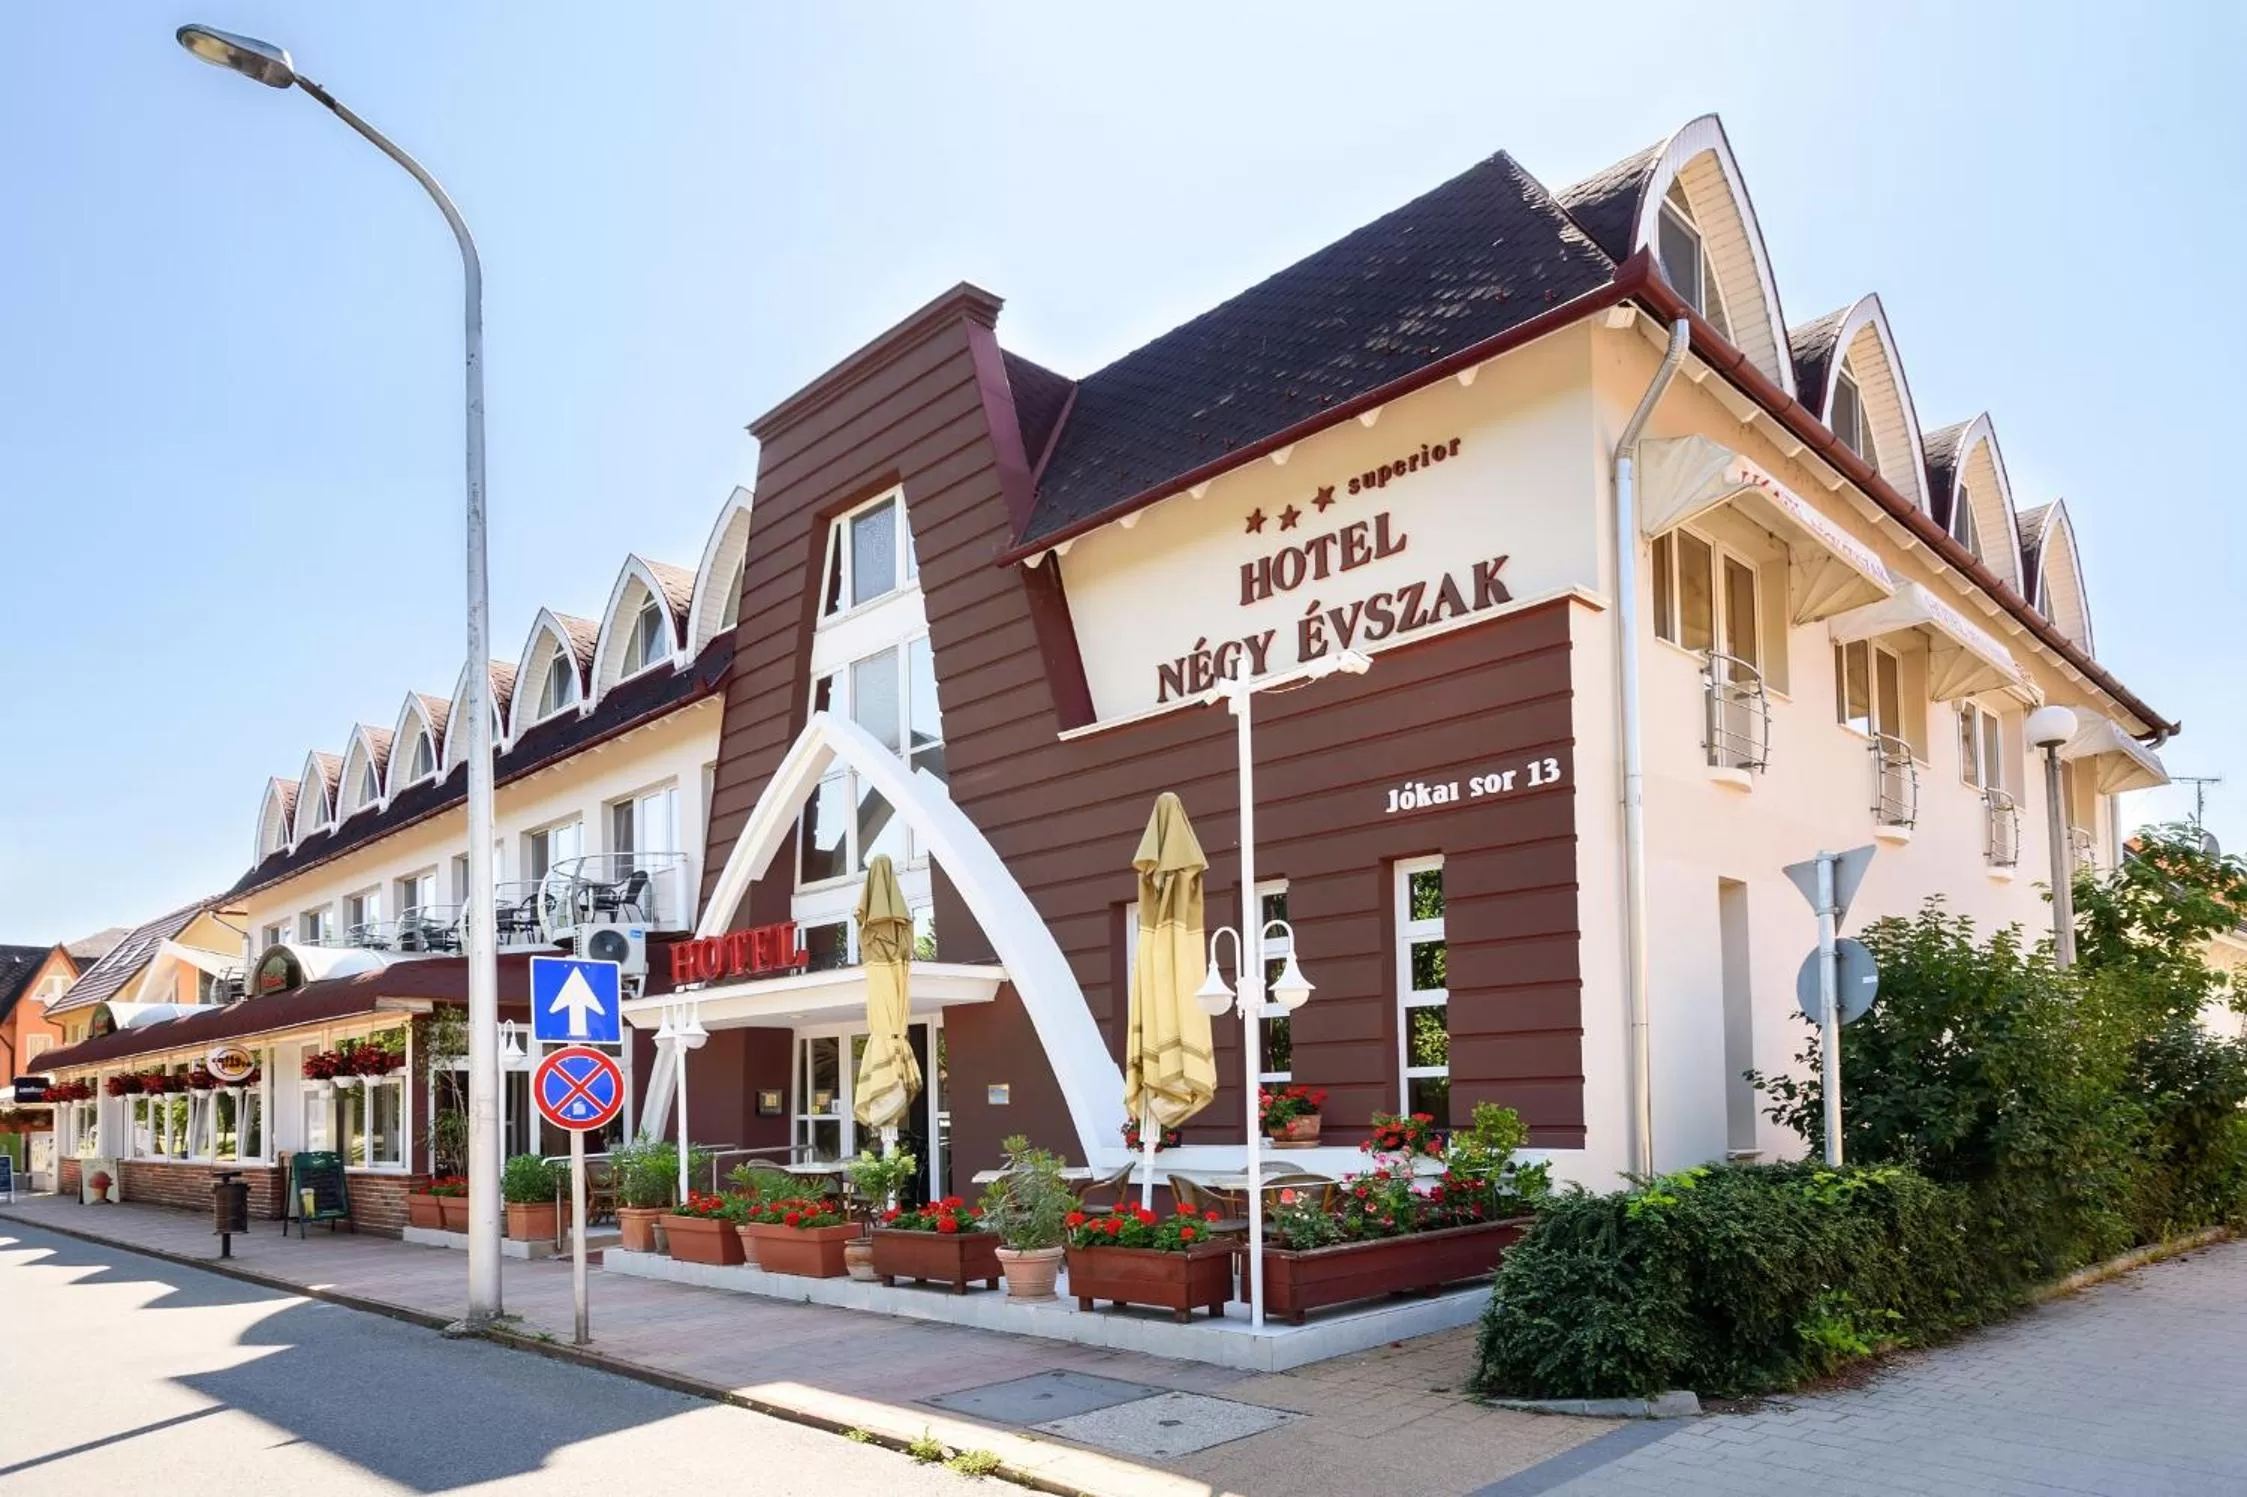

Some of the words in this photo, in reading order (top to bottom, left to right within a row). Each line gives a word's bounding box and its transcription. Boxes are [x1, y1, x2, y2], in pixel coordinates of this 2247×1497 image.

[1348, 437, 1461, 495] superior
[1239, 511, 1407, 606] HOTEL
[1156, 629, 1275, 703] NÉGY
[1297, 555, 1513, 663] ÉVSZAK
[1469, 770, 1517, 797] sor
[1527, 757, 1561, 787] 13
[669, 921, 809, 985] HOTEL
